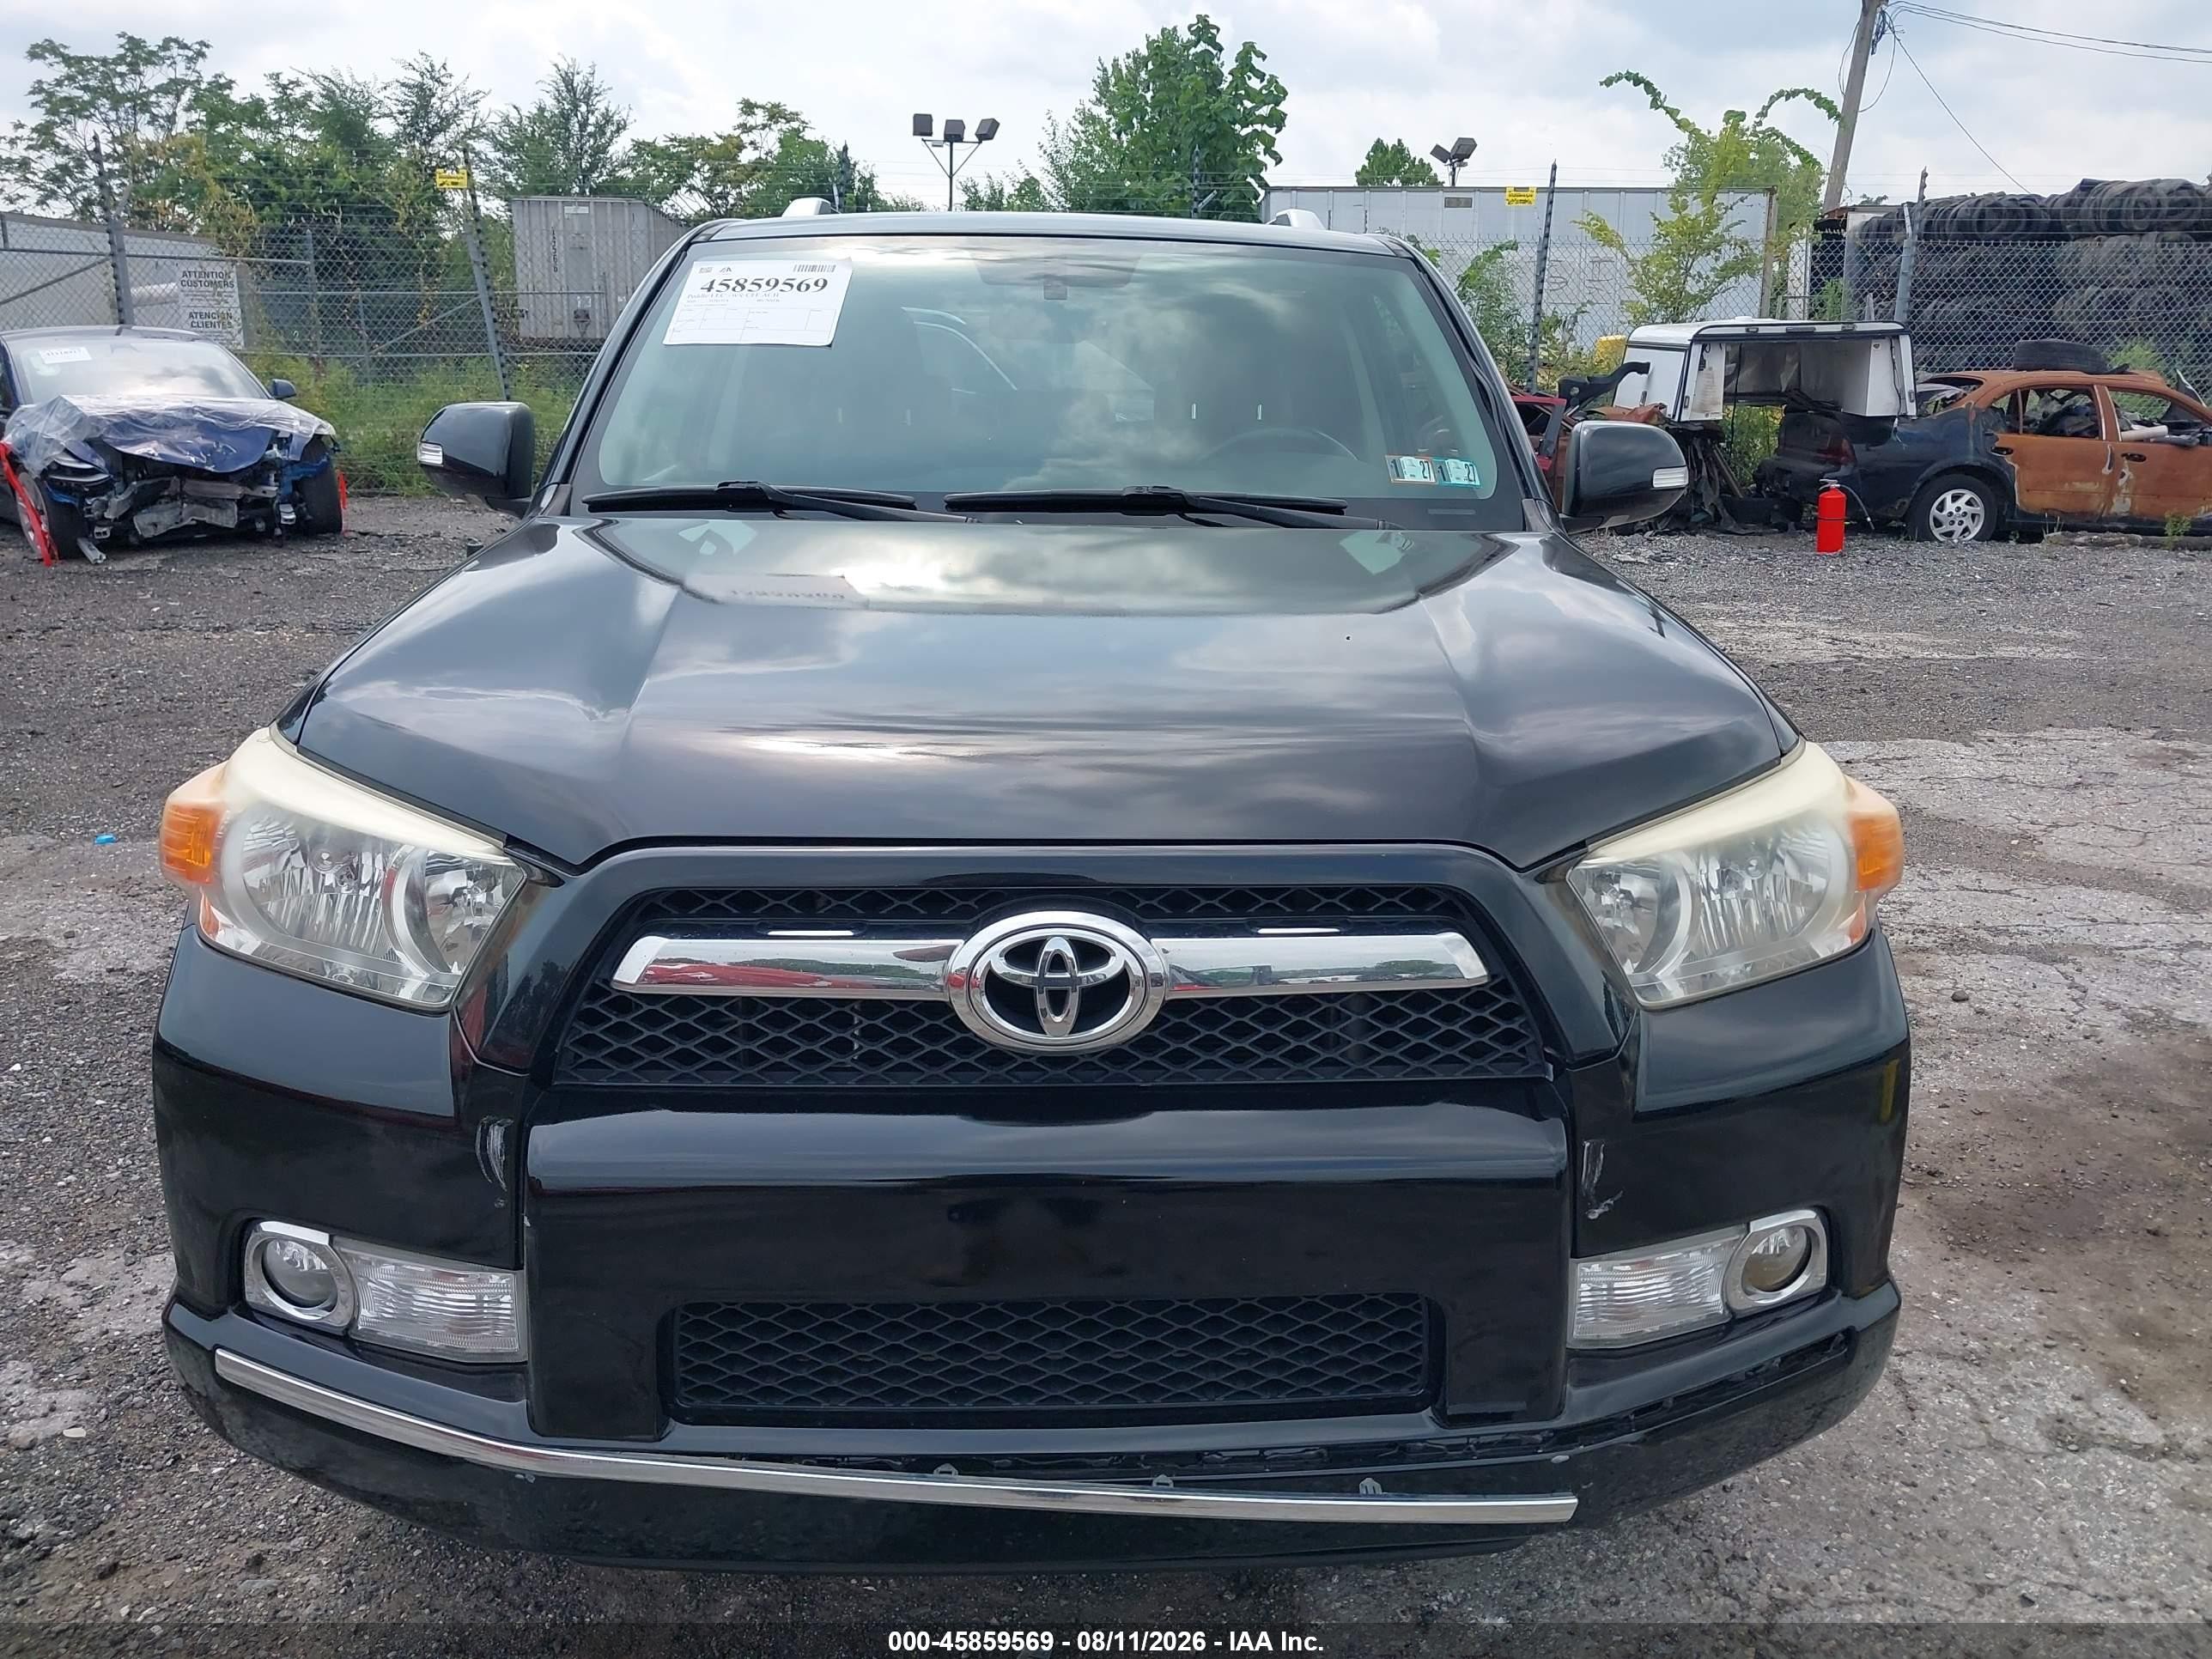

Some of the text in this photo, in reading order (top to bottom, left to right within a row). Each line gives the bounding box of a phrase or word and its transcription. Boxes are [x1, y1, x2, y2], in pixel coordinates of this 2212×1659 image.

[182, 270, 231, 279] ATTENTION
[180, 279, 234, 289] CUSTOMERS
[700, 277, 829, 293] 45859569
[191, 320, 234, 330] CLIENTES
[1419, 460, 1431, 482] 27
[1464, 463, 1476, 482] 27
